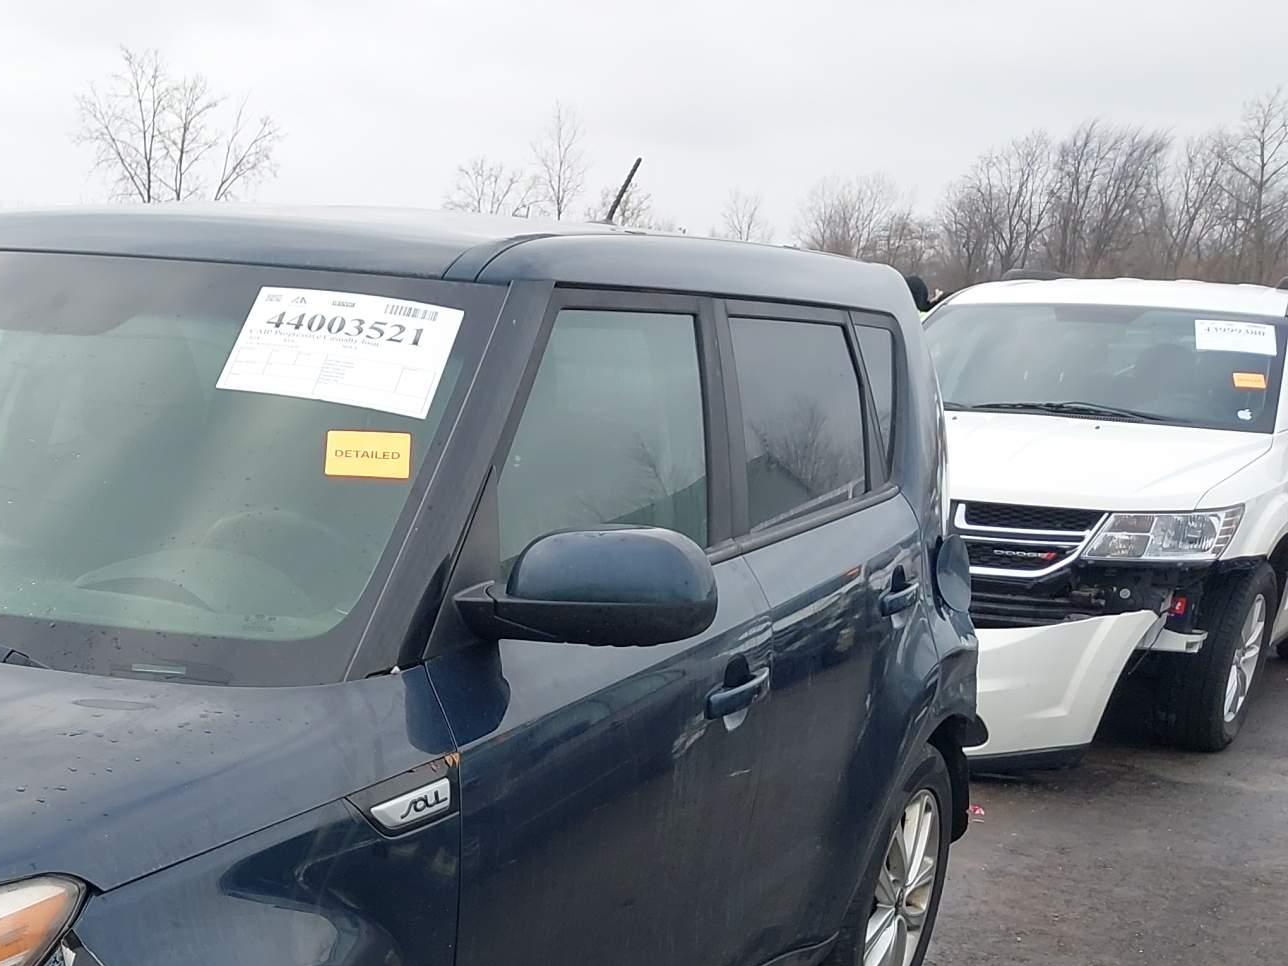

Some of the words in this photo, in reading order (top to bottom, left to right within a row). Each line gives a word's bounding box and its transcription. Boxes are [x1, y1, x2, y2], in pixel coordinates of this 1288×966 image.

[266, 311, 424, 346] 44003521
[334, 448, 401, 461] DETAILED
[992, 549, 1048, 559] DODGE
[400, 789, 448, 820] SOUL
